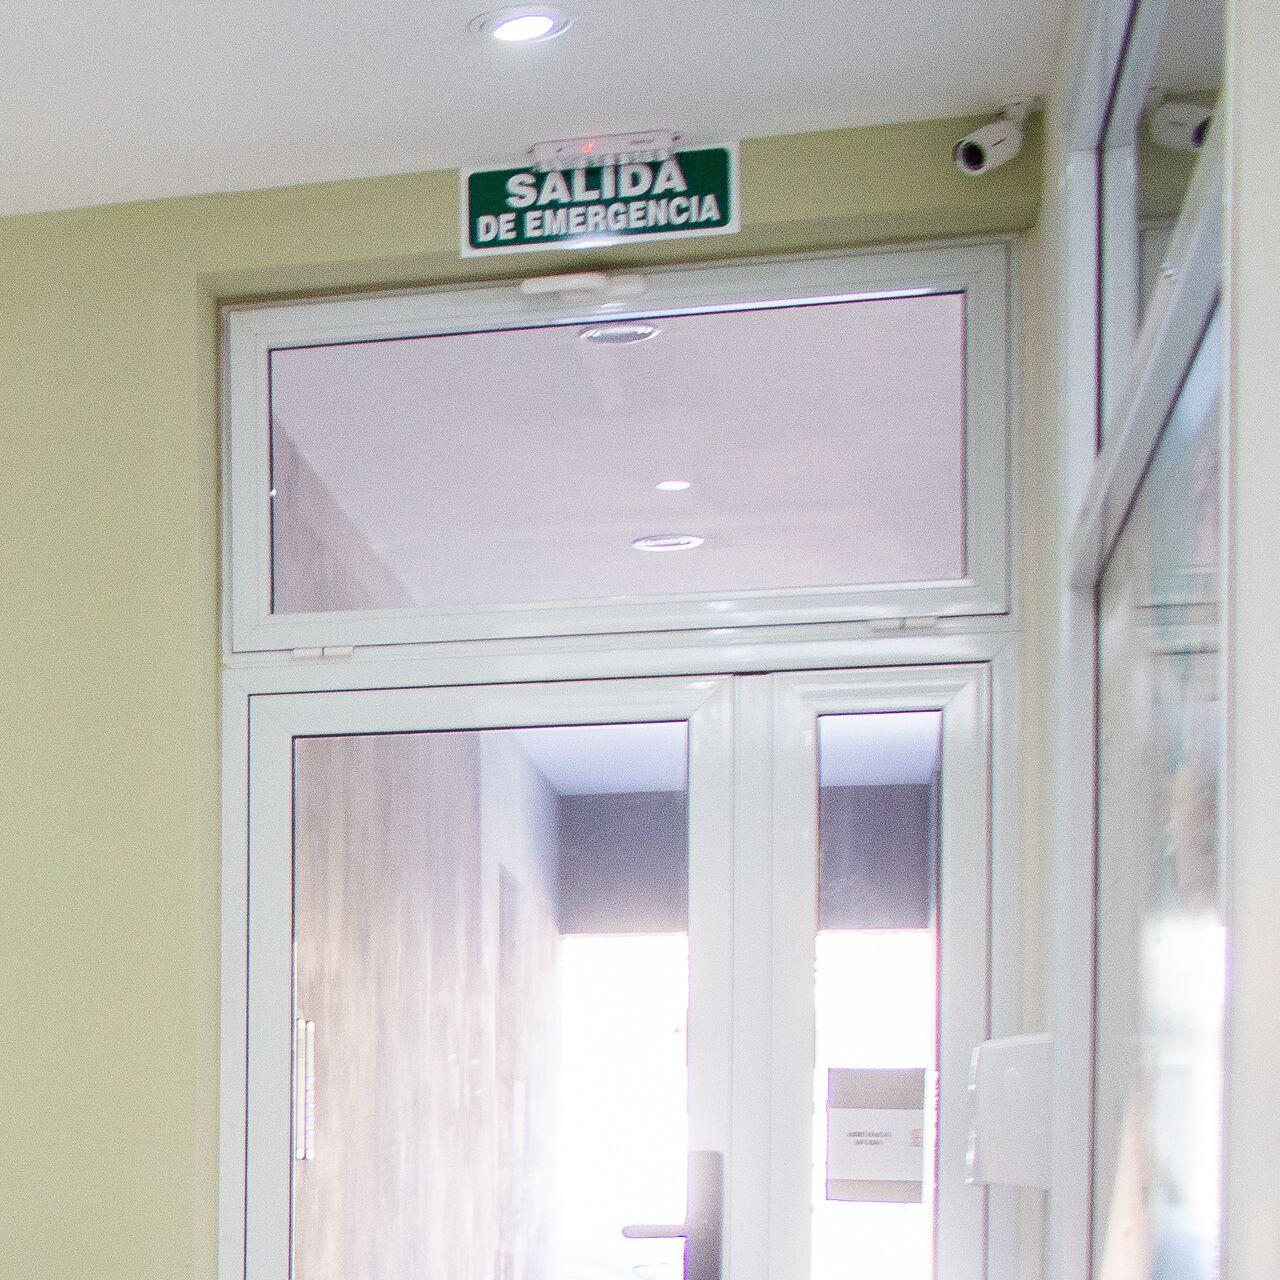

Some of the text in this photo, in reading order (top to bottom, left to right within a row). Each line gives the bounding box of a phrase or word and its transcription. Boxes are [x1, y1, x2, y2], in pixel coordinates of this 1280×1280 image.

[505, 159, 688, 209] SALIDA
[477, 193, 721, 243] DE EMERGENCIA
